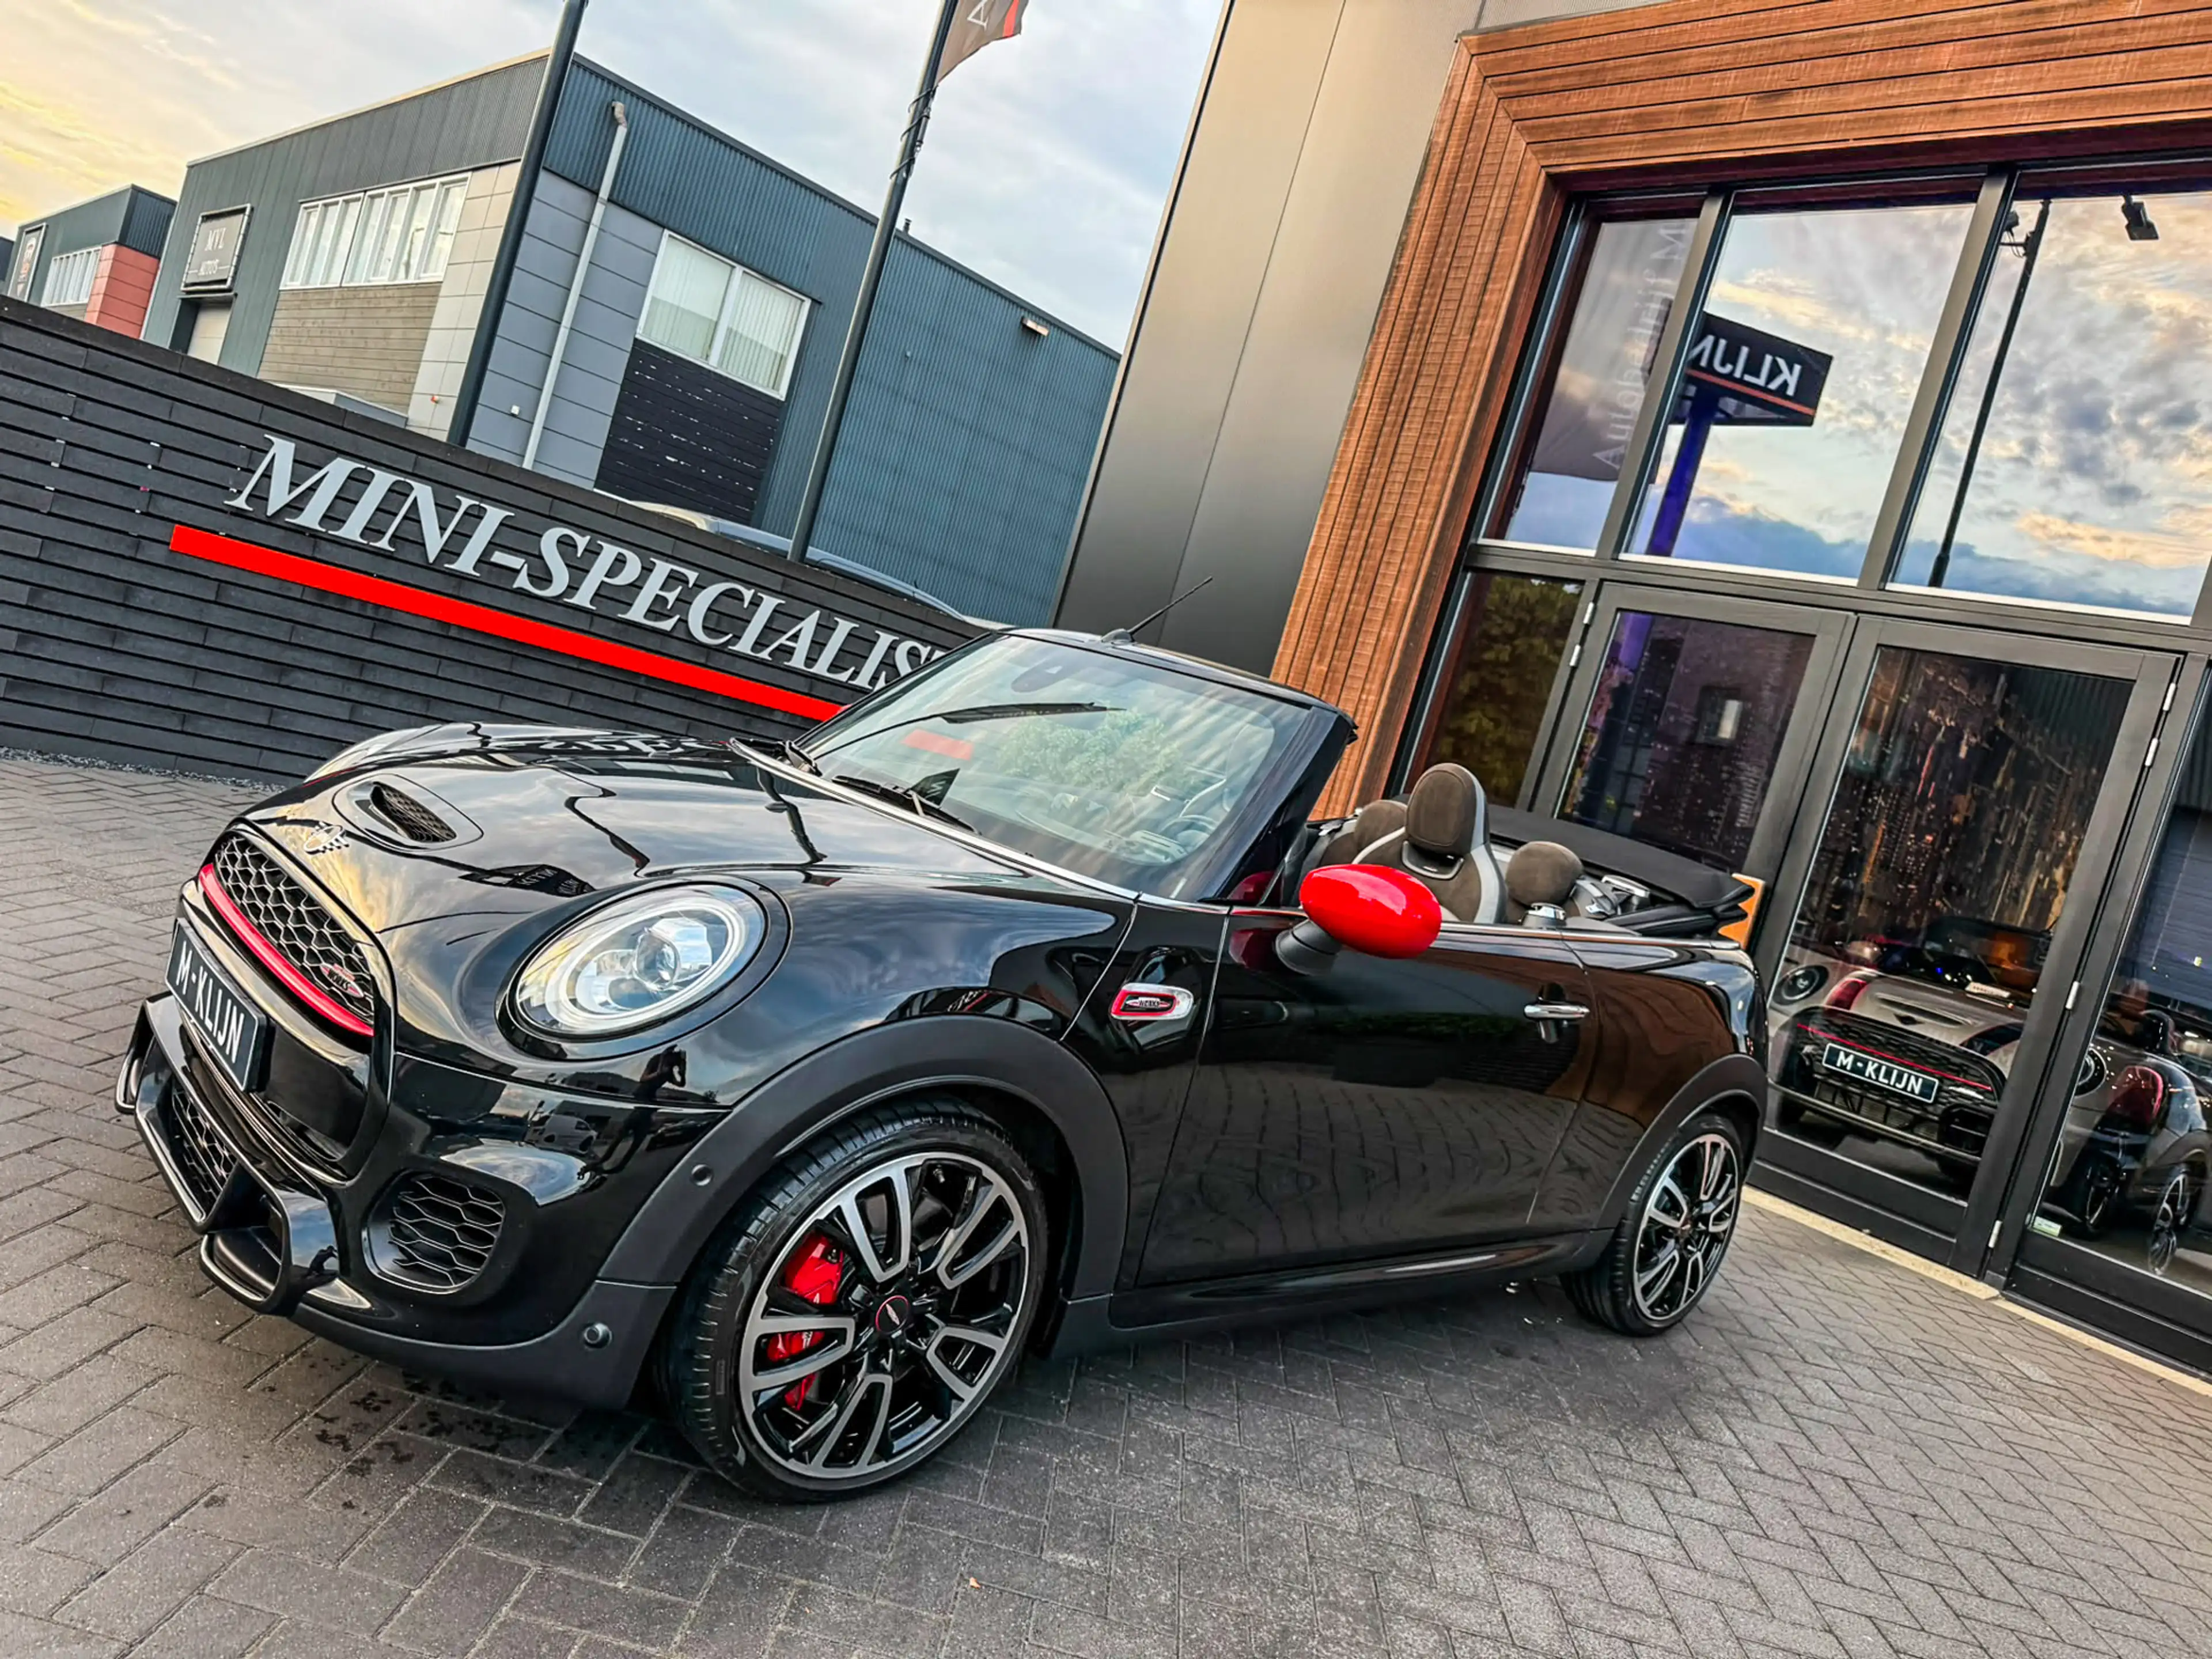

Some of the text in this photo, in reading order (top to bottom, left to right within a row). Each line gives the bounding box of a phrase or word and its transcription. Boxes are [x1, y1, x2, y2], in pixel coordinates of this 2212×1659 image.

[223, 434, 946, 692] MINI-SPECIALIS
[176, 940, 245, 1064] M-KLIJN
[1836, 1051, 1923, 1095] M-KLIJN
